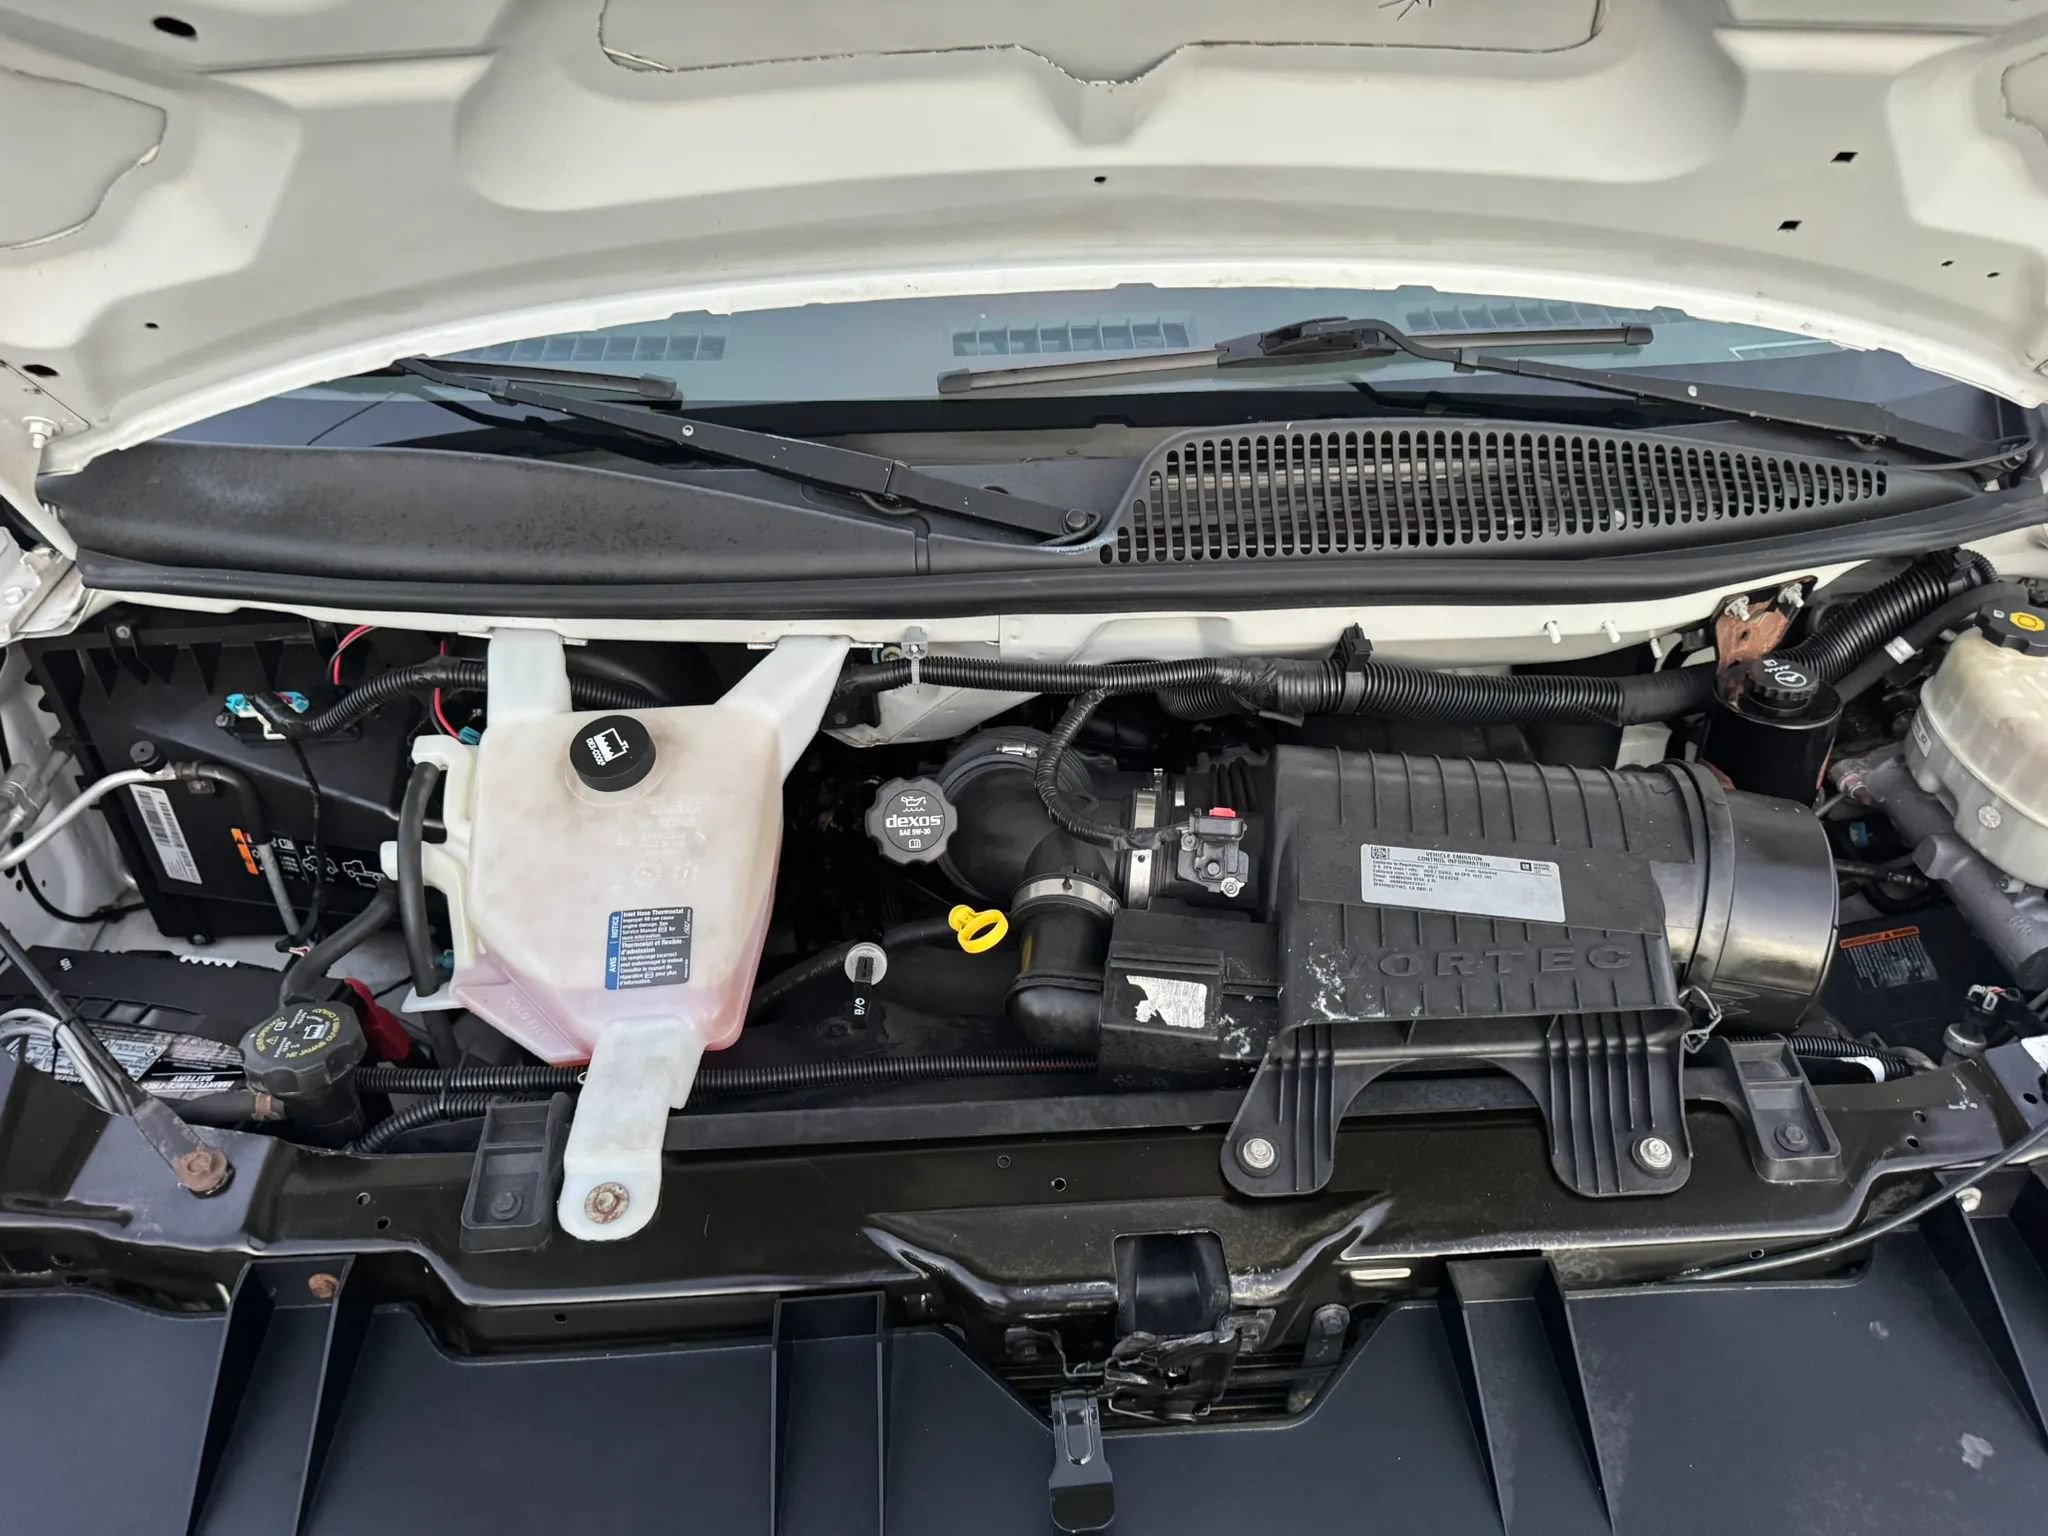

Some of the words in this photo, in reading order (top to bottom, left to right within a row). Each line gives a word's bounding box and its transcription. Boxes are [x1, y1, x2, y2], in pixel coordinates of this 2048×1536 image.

[885, 814, 943, 828] dexos
[899, 828, 911, 836] SAE
[912, 828, 931, 836] 5W-30
[1425, 851, 1450, 859] VEHICLE
[1448, 859, 1490, 867] INFORMATION
[611, 916, 620, 938] NOTICE
[609, 956, 617, 973] AVIS
[54, 1073, 83, 1083] ANGER
[171, 1074, 215, 1082] BATTERY
[141, 1080, 235, 1091] MAINTENANCE-FREE
